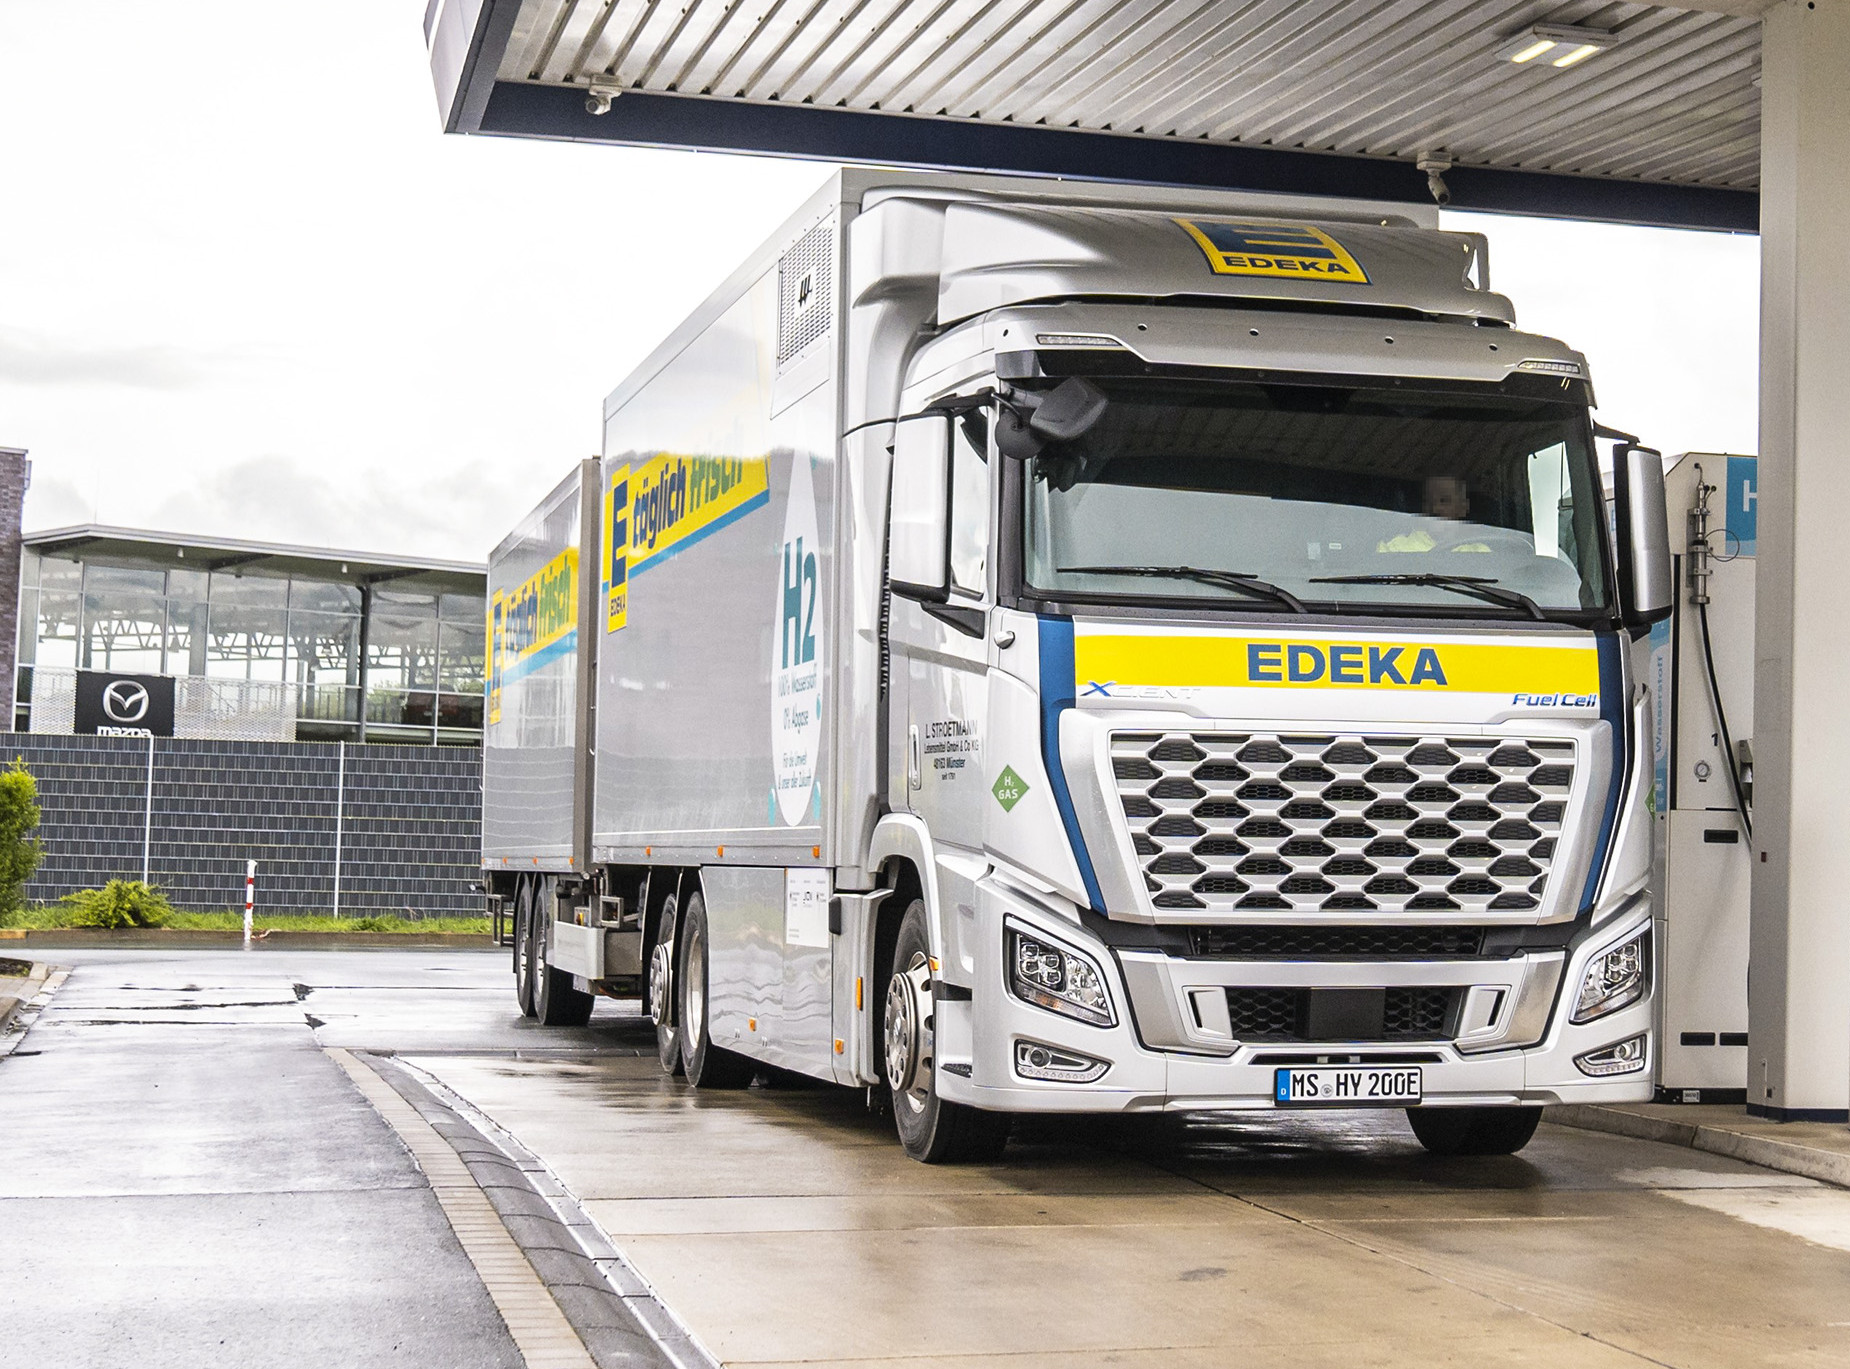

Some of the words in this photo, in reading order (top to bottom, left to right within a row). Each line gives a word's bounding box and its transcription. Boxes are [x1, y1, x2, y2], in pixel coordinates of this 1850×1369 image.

[1222, 256, 1351, 274] EDEKA
[632, 458, 686, 549] täglich
[612, 479, 628, 588] E
[782, 536, 816, 670] H2
[1247, 643, 1449, 687] EDEKA
[1511, 693, 1558, 707] Fuel
[1560, 694, 1597, 707] Cell
[97, 725, 153, 737] mazda
[947, 740, 959, 753] GmbH
[1711, 733, 1718, 746] 1
[946, 756, 966, 769] Münster
[998, 789, 1018, 800] GAS
[1280, 1088, 1287, 1096] D
[1292, 1073, 1318, 1097] MS
[1336, 1073, 1362, 1097] HY
[1368, 1072, 1418, 1096] 200E
